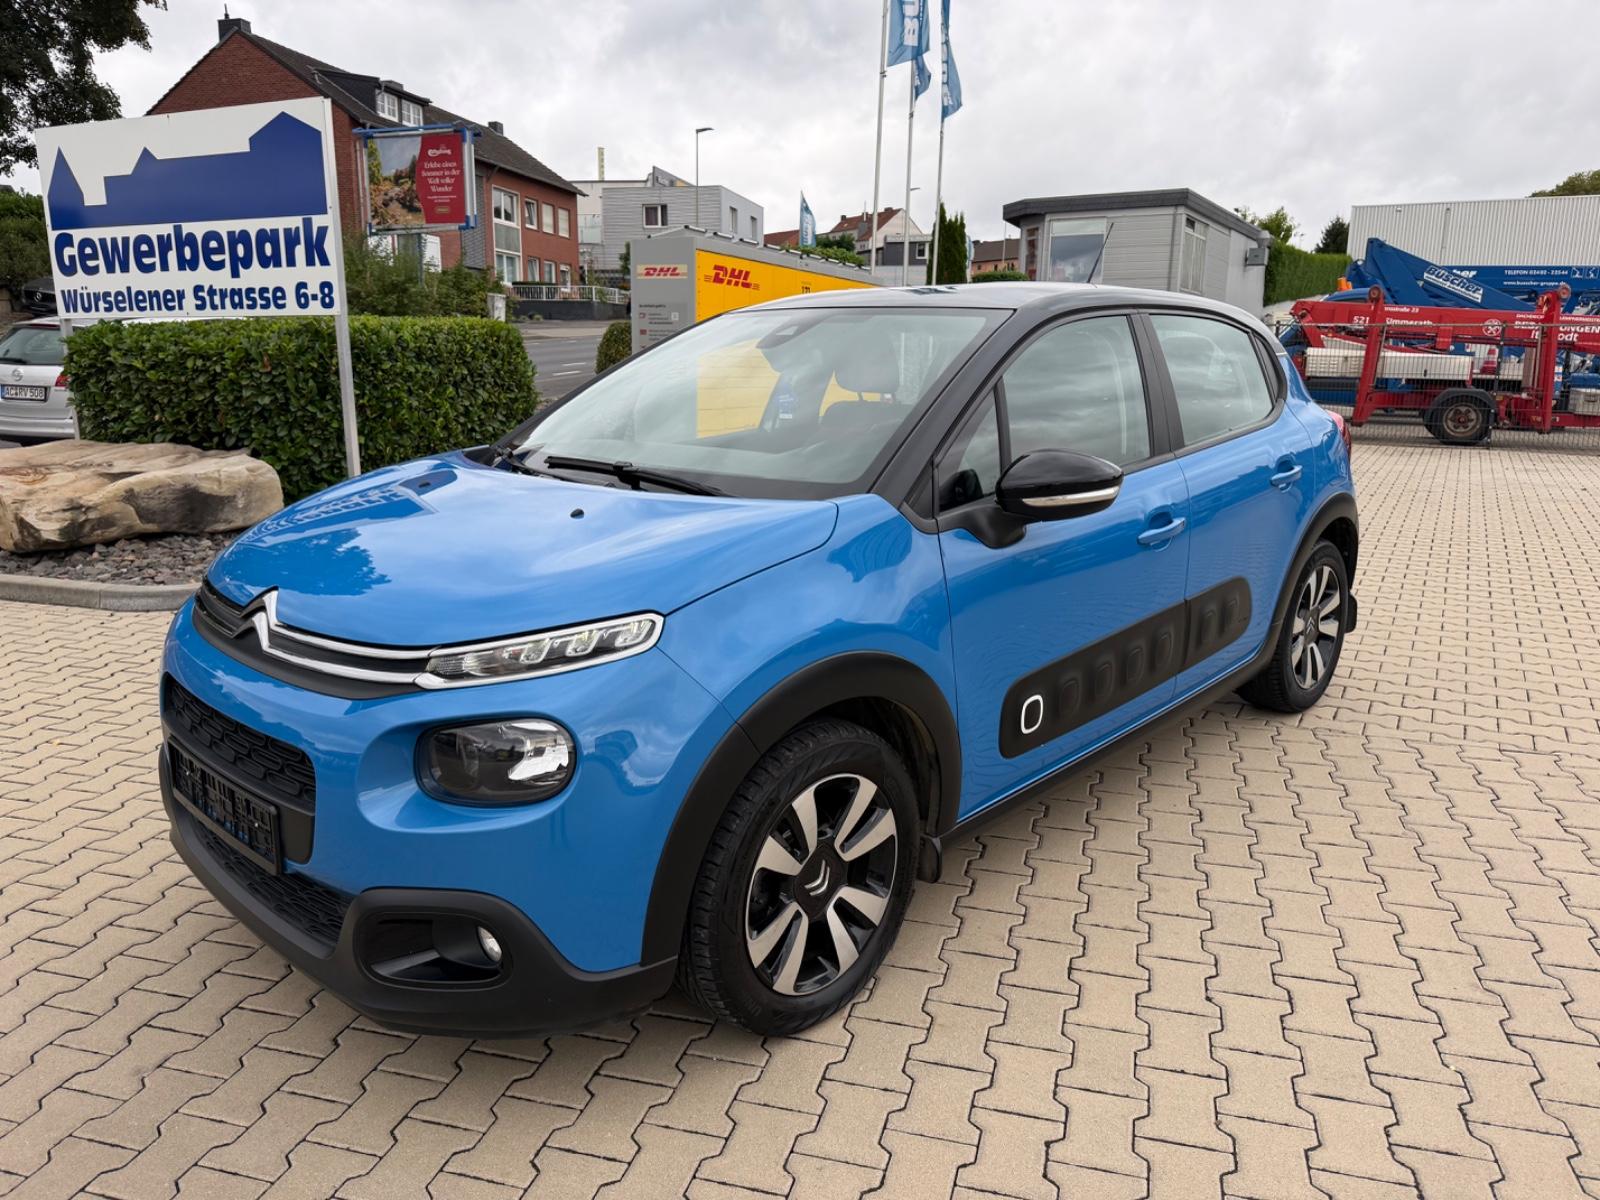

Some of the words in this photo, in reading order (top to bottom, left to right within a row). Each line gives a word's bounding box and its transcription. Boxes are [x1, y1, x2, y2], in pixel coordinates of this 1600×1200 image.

[54, 216, 331, 279] Gewerbepark
[643, 266, 681, 277] DHL
[712, 264, 753, 289] DHL
[61, 285, 186, 313] Würselener
[193, 283, 287, 311] Strasse
[295, 280, 335, 309] 6-8
